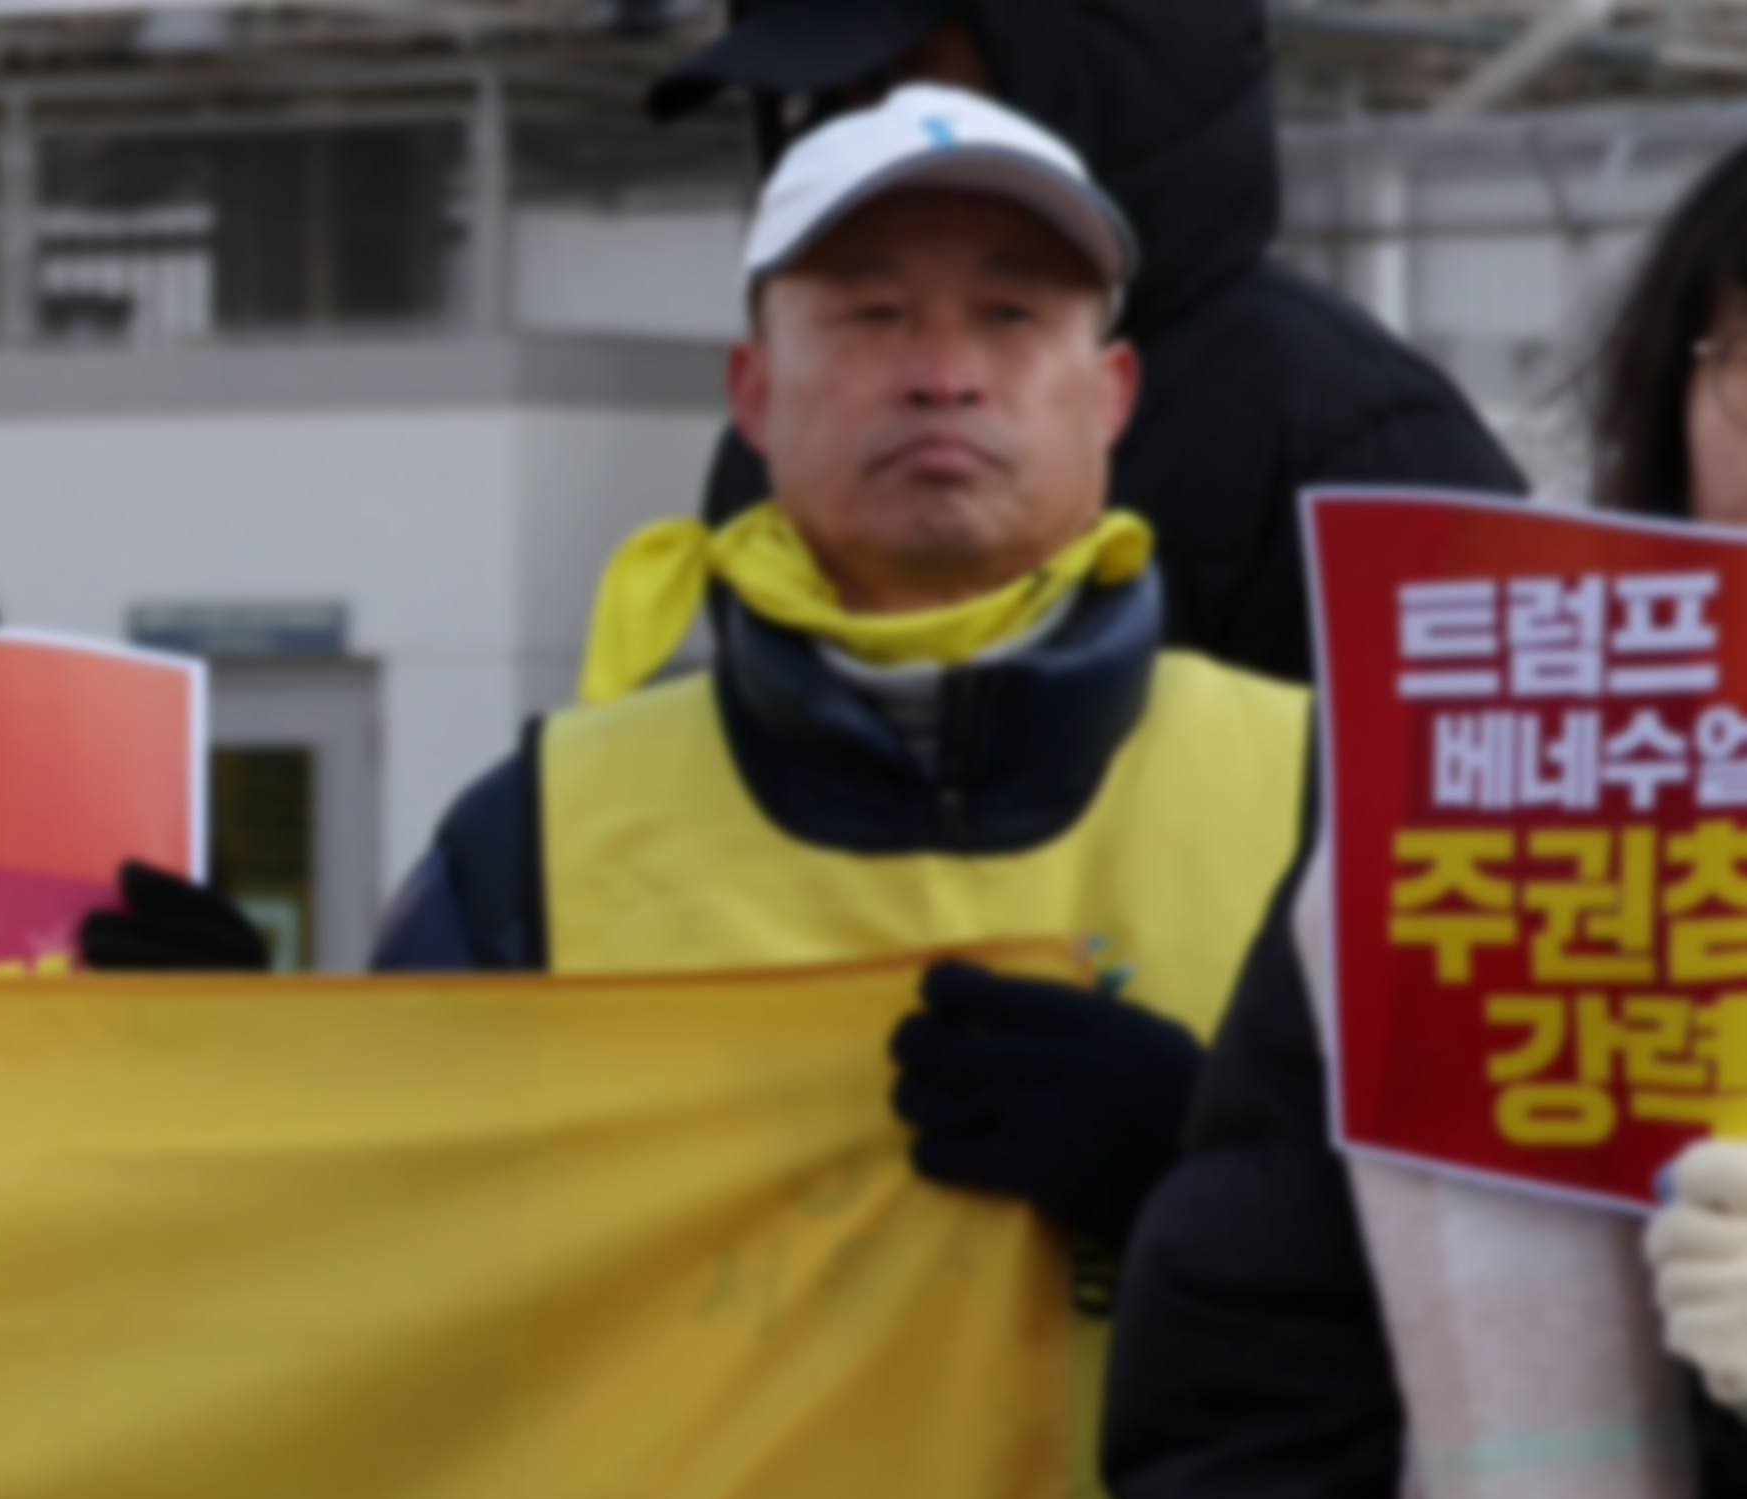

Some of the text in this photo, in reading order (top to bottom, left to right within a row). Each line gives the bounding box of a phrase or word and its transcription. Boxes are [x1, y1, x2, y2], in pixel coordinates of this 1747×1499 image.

[1395, 569, 1719, 700] 트럼프
[1431, 703, 1747, 812] 베네수엘
[1387, 818, 1747, 985] 주권침
